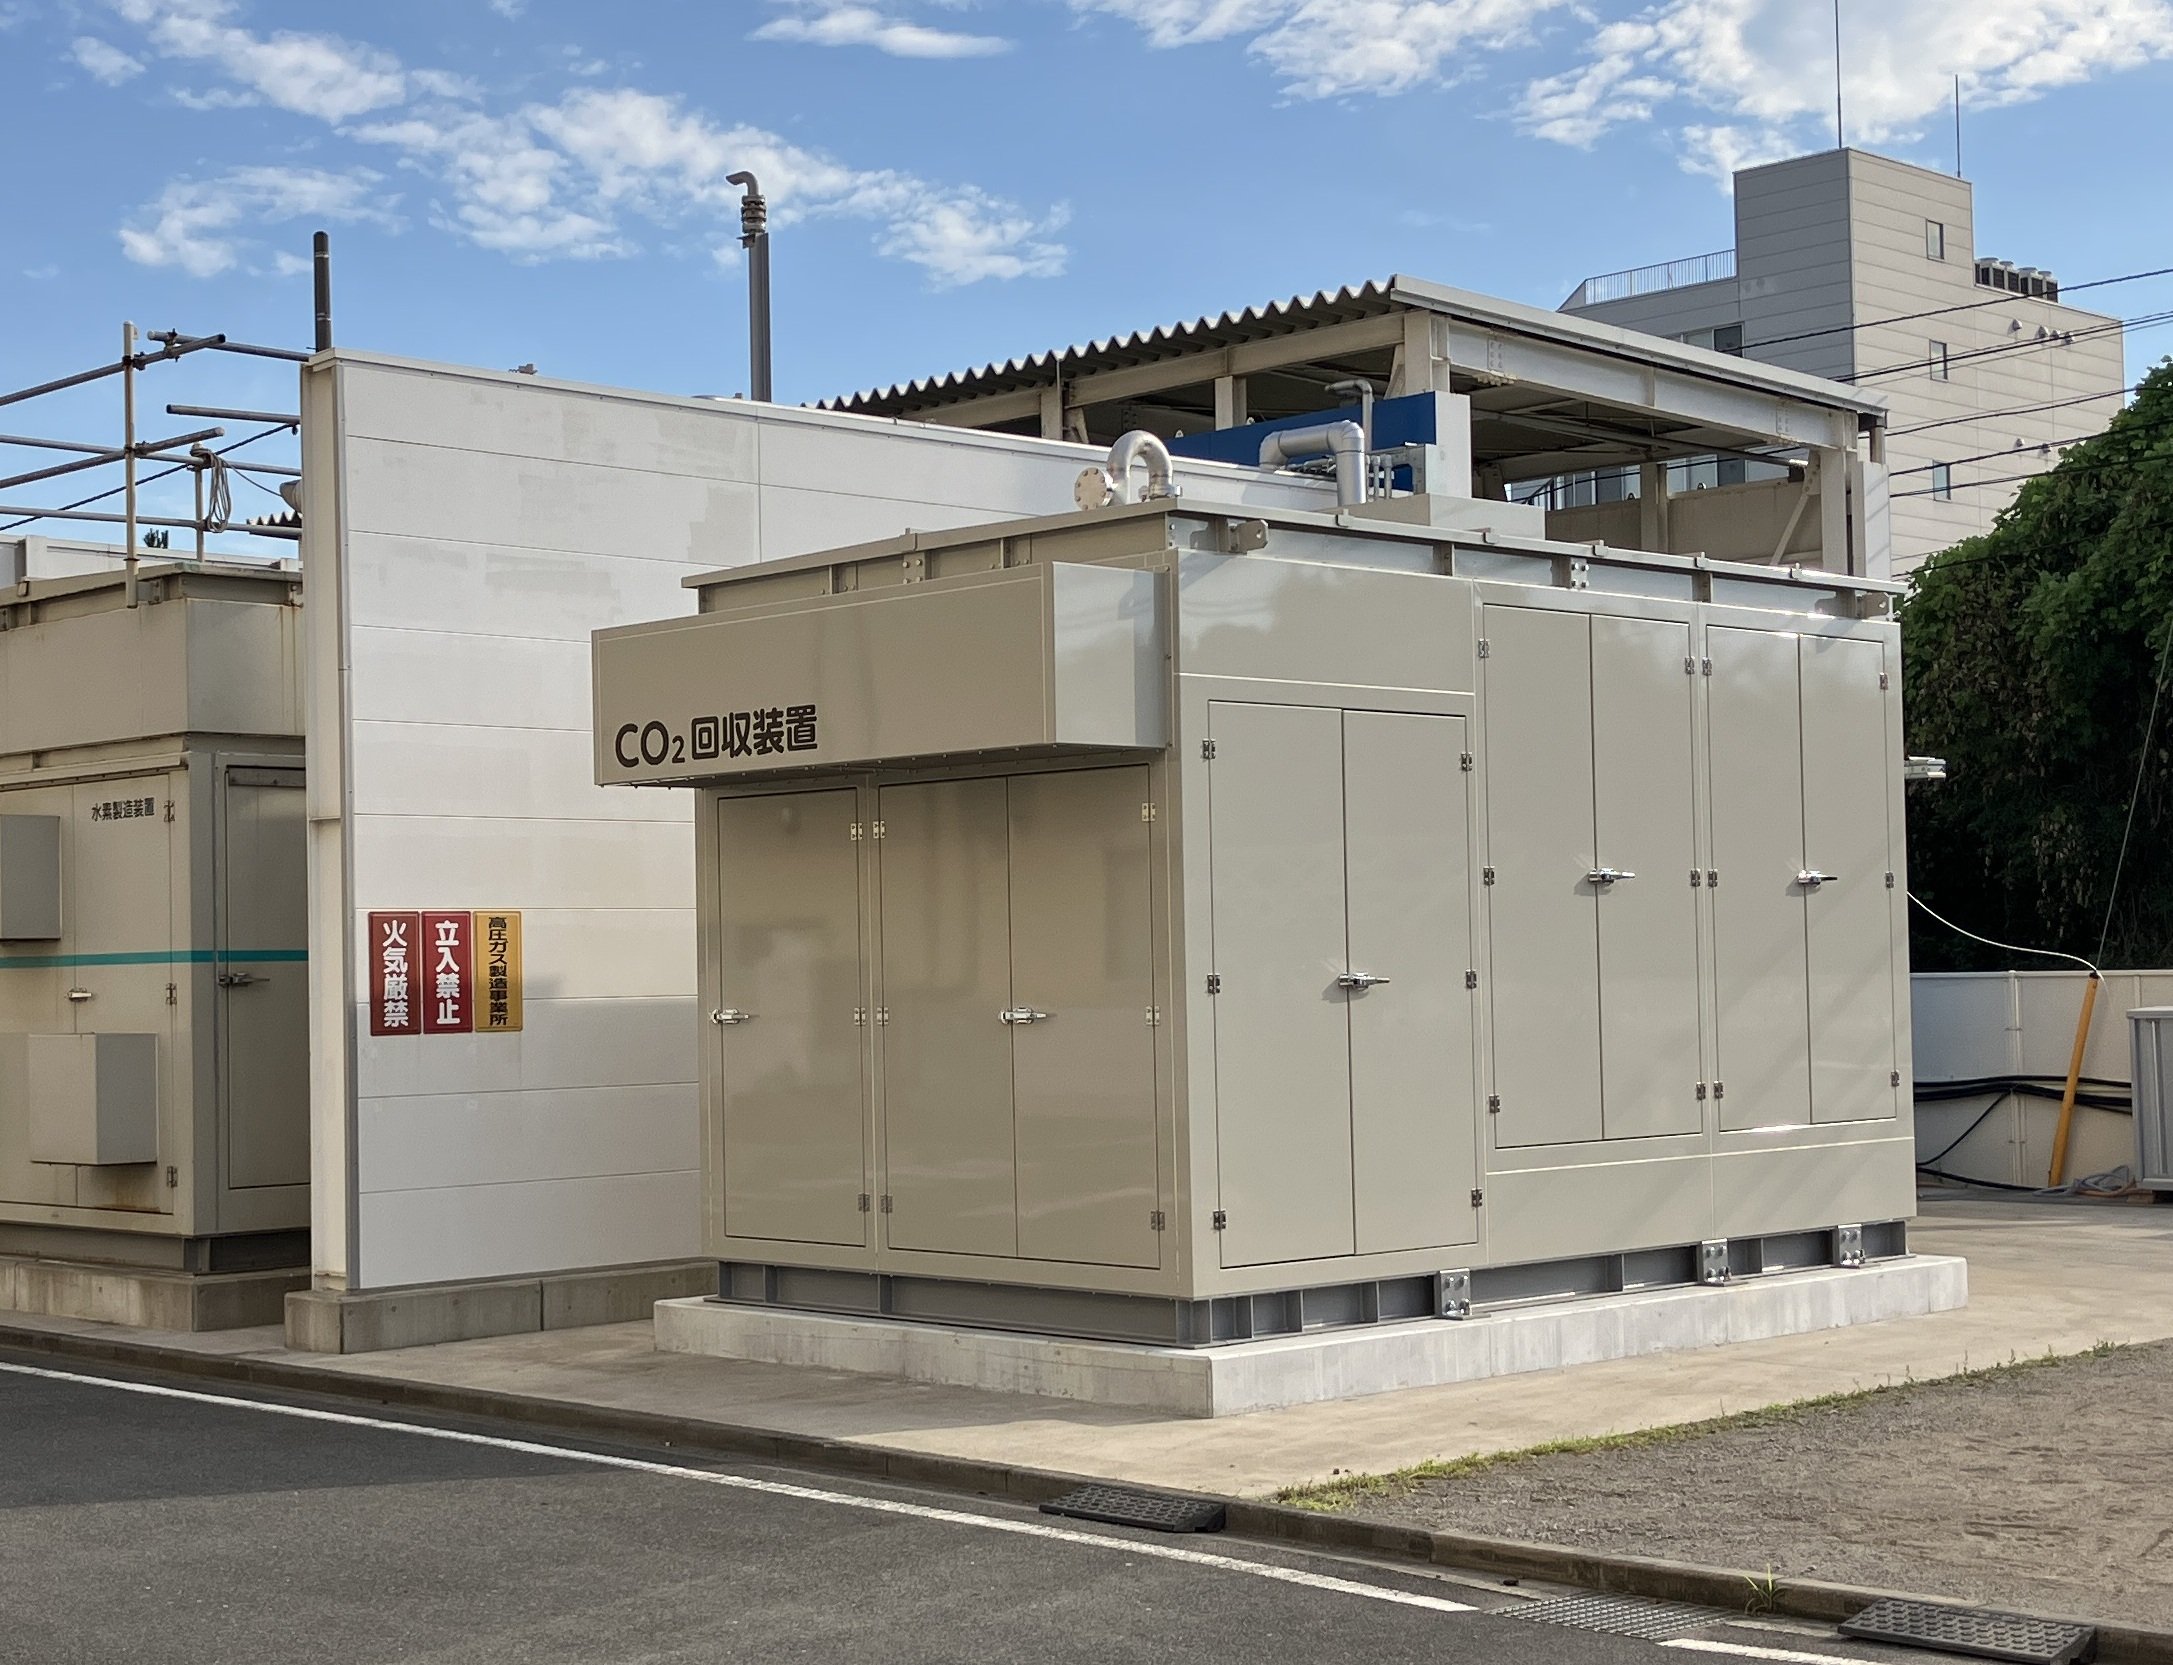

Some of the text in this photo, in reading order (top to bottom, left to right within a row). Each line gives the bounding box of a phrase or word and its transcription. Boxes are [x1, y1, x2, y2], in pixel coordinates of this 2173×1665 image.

[91, 797, 155, 822] 水素製造装置
[382, 919, 409, 1028] 火気厳禁
[434, 919, 461, 1025] 立入禁止
[488, 916, 509, 1026] 高圧ガス製造事業所
